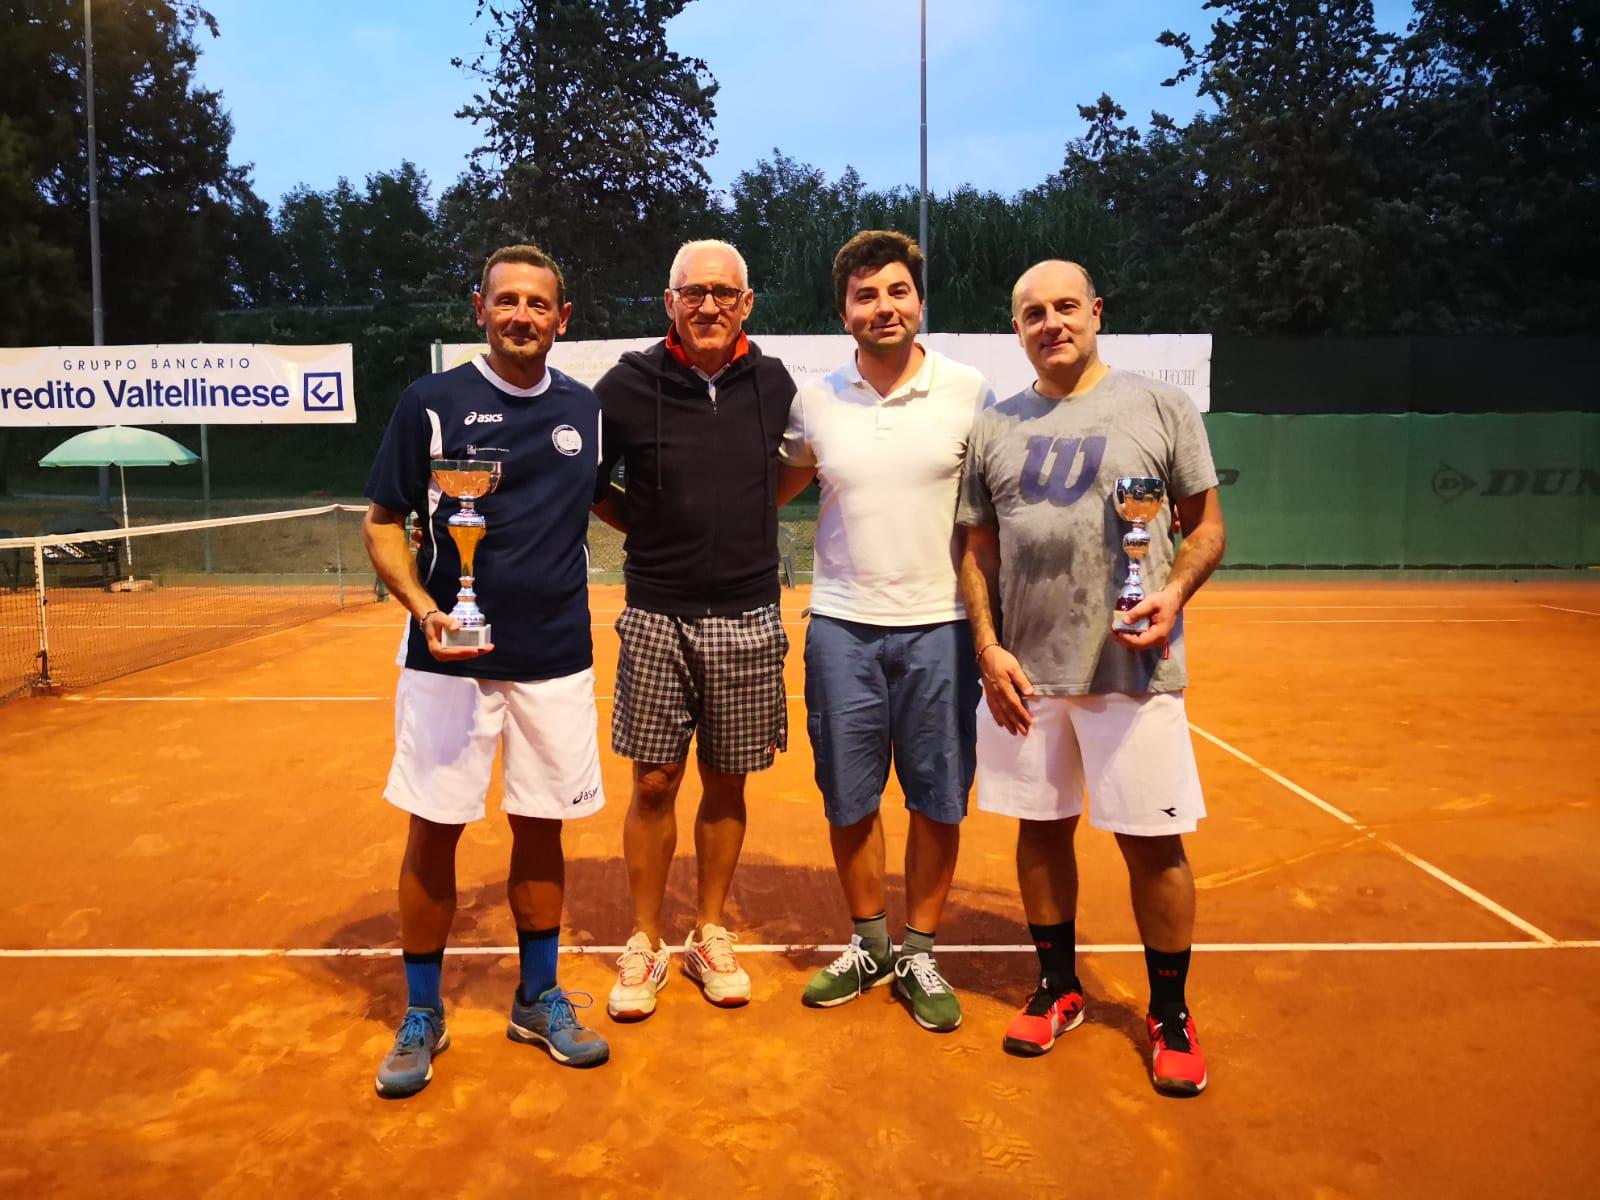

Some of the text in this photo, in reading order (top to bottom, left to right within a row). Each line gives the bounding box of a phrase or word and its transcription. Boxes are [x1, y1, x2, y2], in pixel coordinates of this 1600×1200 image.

[63, 357, 251, 371] GRUPPO BANCARIO
[0, 378, 290, 410] redito Valtellinese
